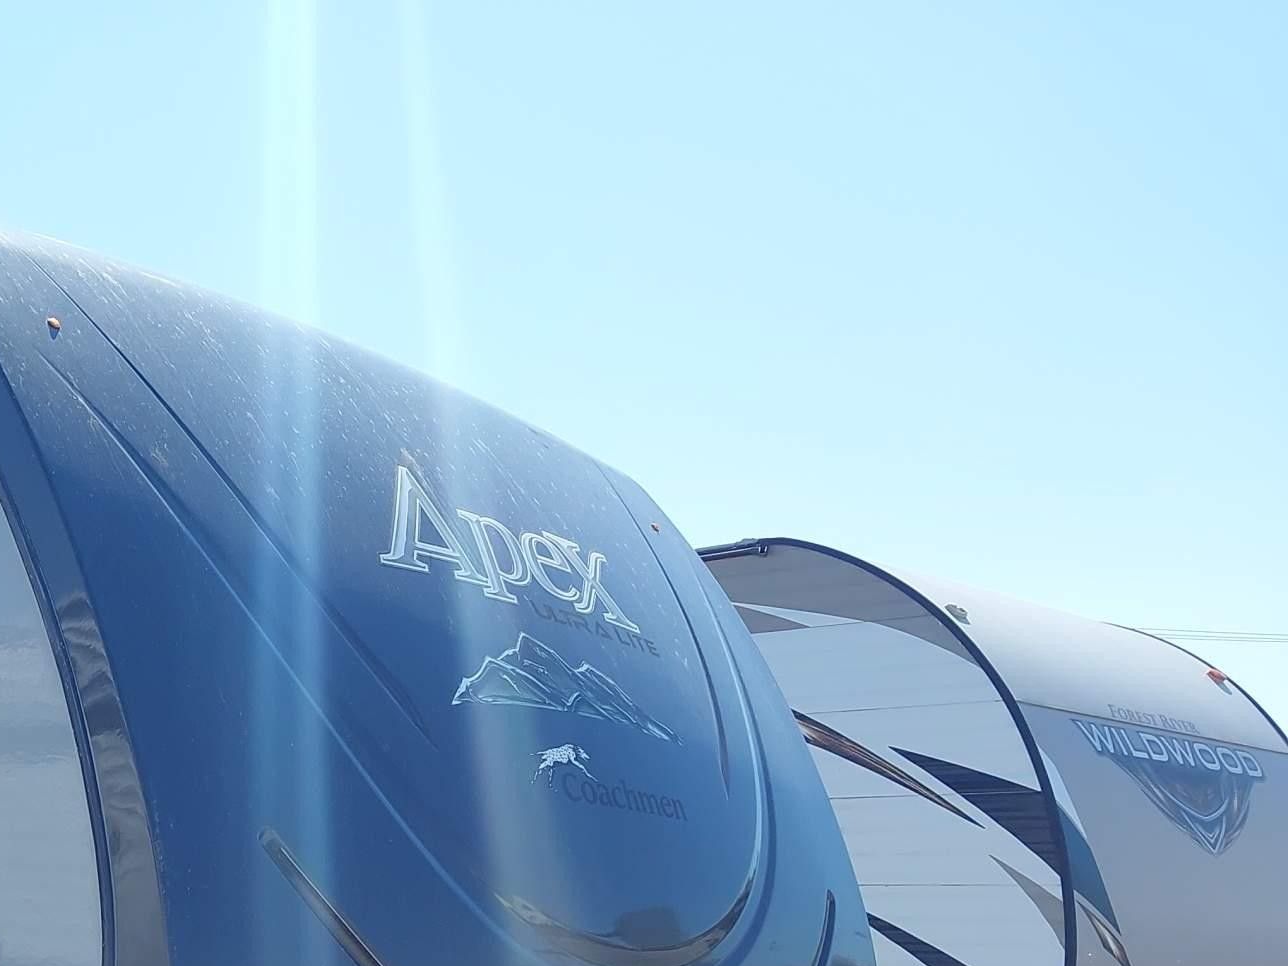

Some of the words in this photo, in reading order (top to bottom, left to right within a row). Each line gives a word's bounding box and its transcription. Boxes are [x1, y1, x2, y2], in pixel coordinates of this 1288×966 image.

[379, 464, 640, 634] Apex
[613, 625, 660, 658] LITE
[1070, 717, 1264, 778] WILDWOOD
[561, 772, 688, 822] Coachmen
